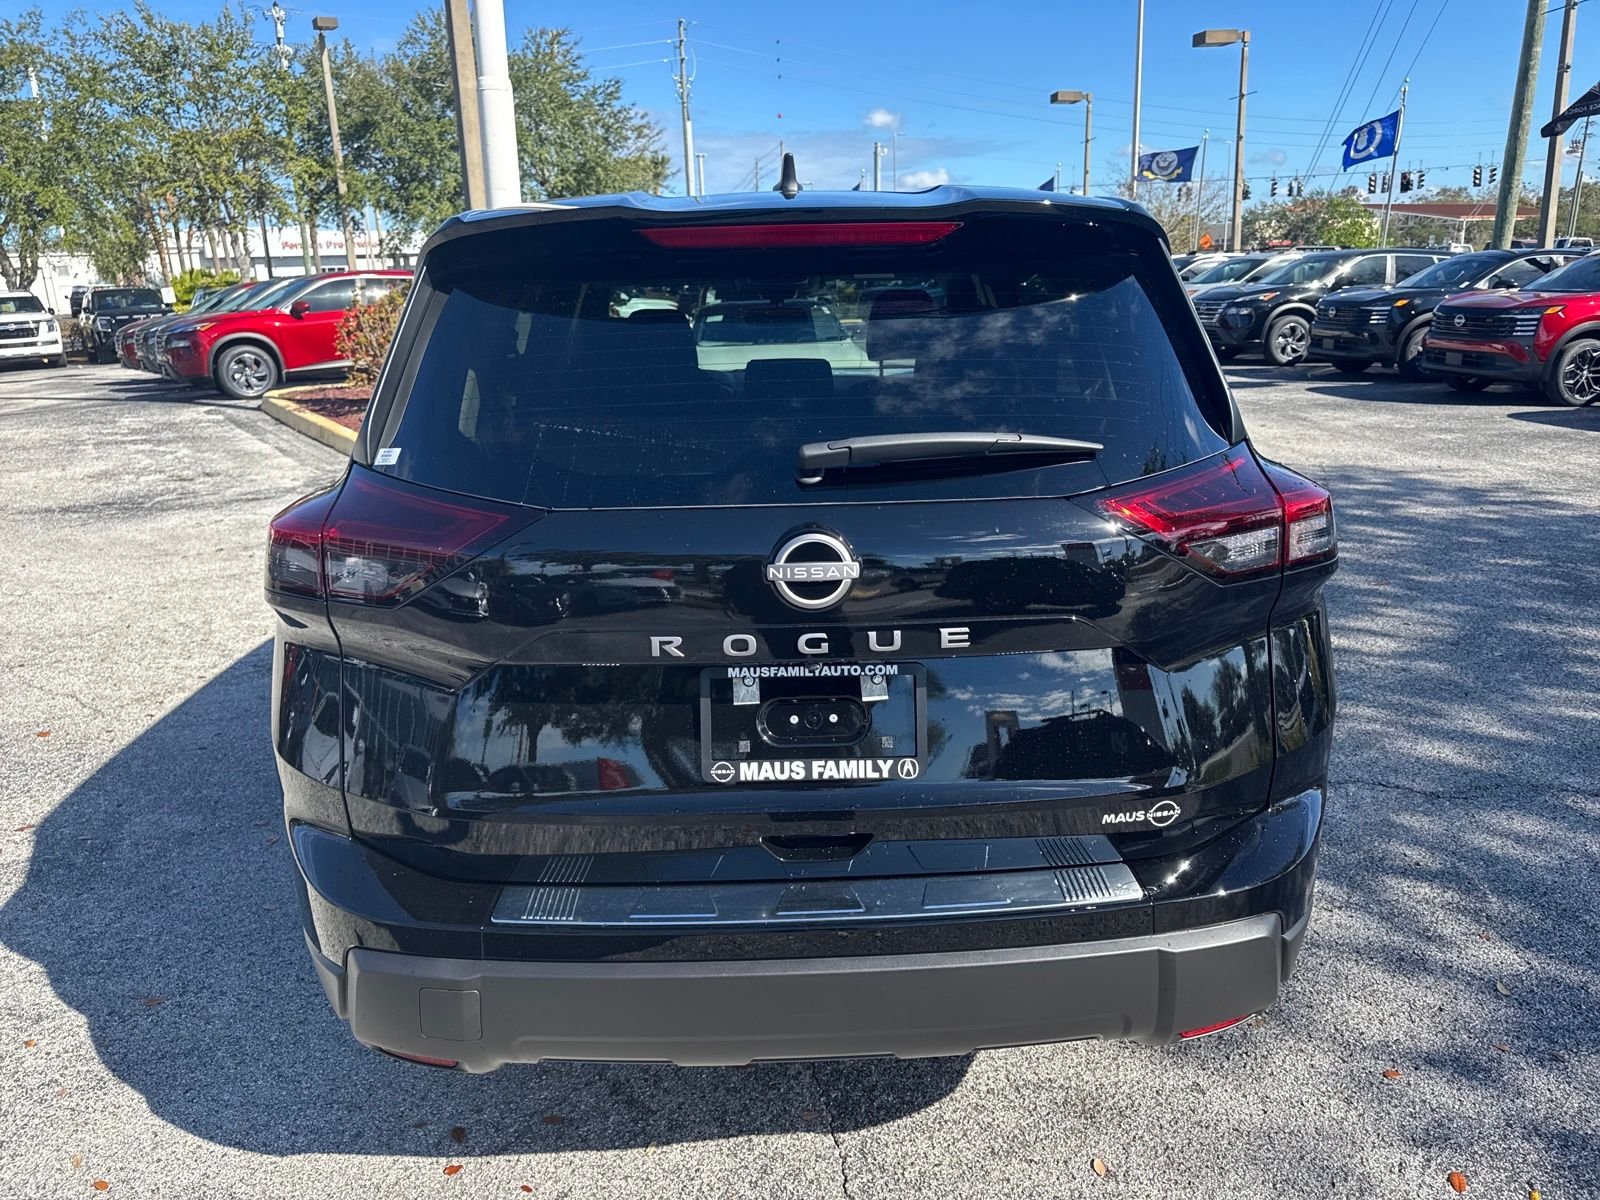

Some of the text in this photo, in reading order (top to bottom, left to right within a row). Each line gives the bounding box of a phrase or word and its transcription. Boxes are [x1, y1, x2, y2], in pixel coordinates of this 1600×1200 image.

[768, 565, 858, 580] NISSAN
[650, 627, 971, 657] ROGUE
[727, 664, 898, 678] MAUSFAMILYAUTO.COM
[739, 761, 805, 781] MAUS
[811, 760, 894, 780] FAMILY
[1101, 807, 1181, 825] MAUS NISSAN
